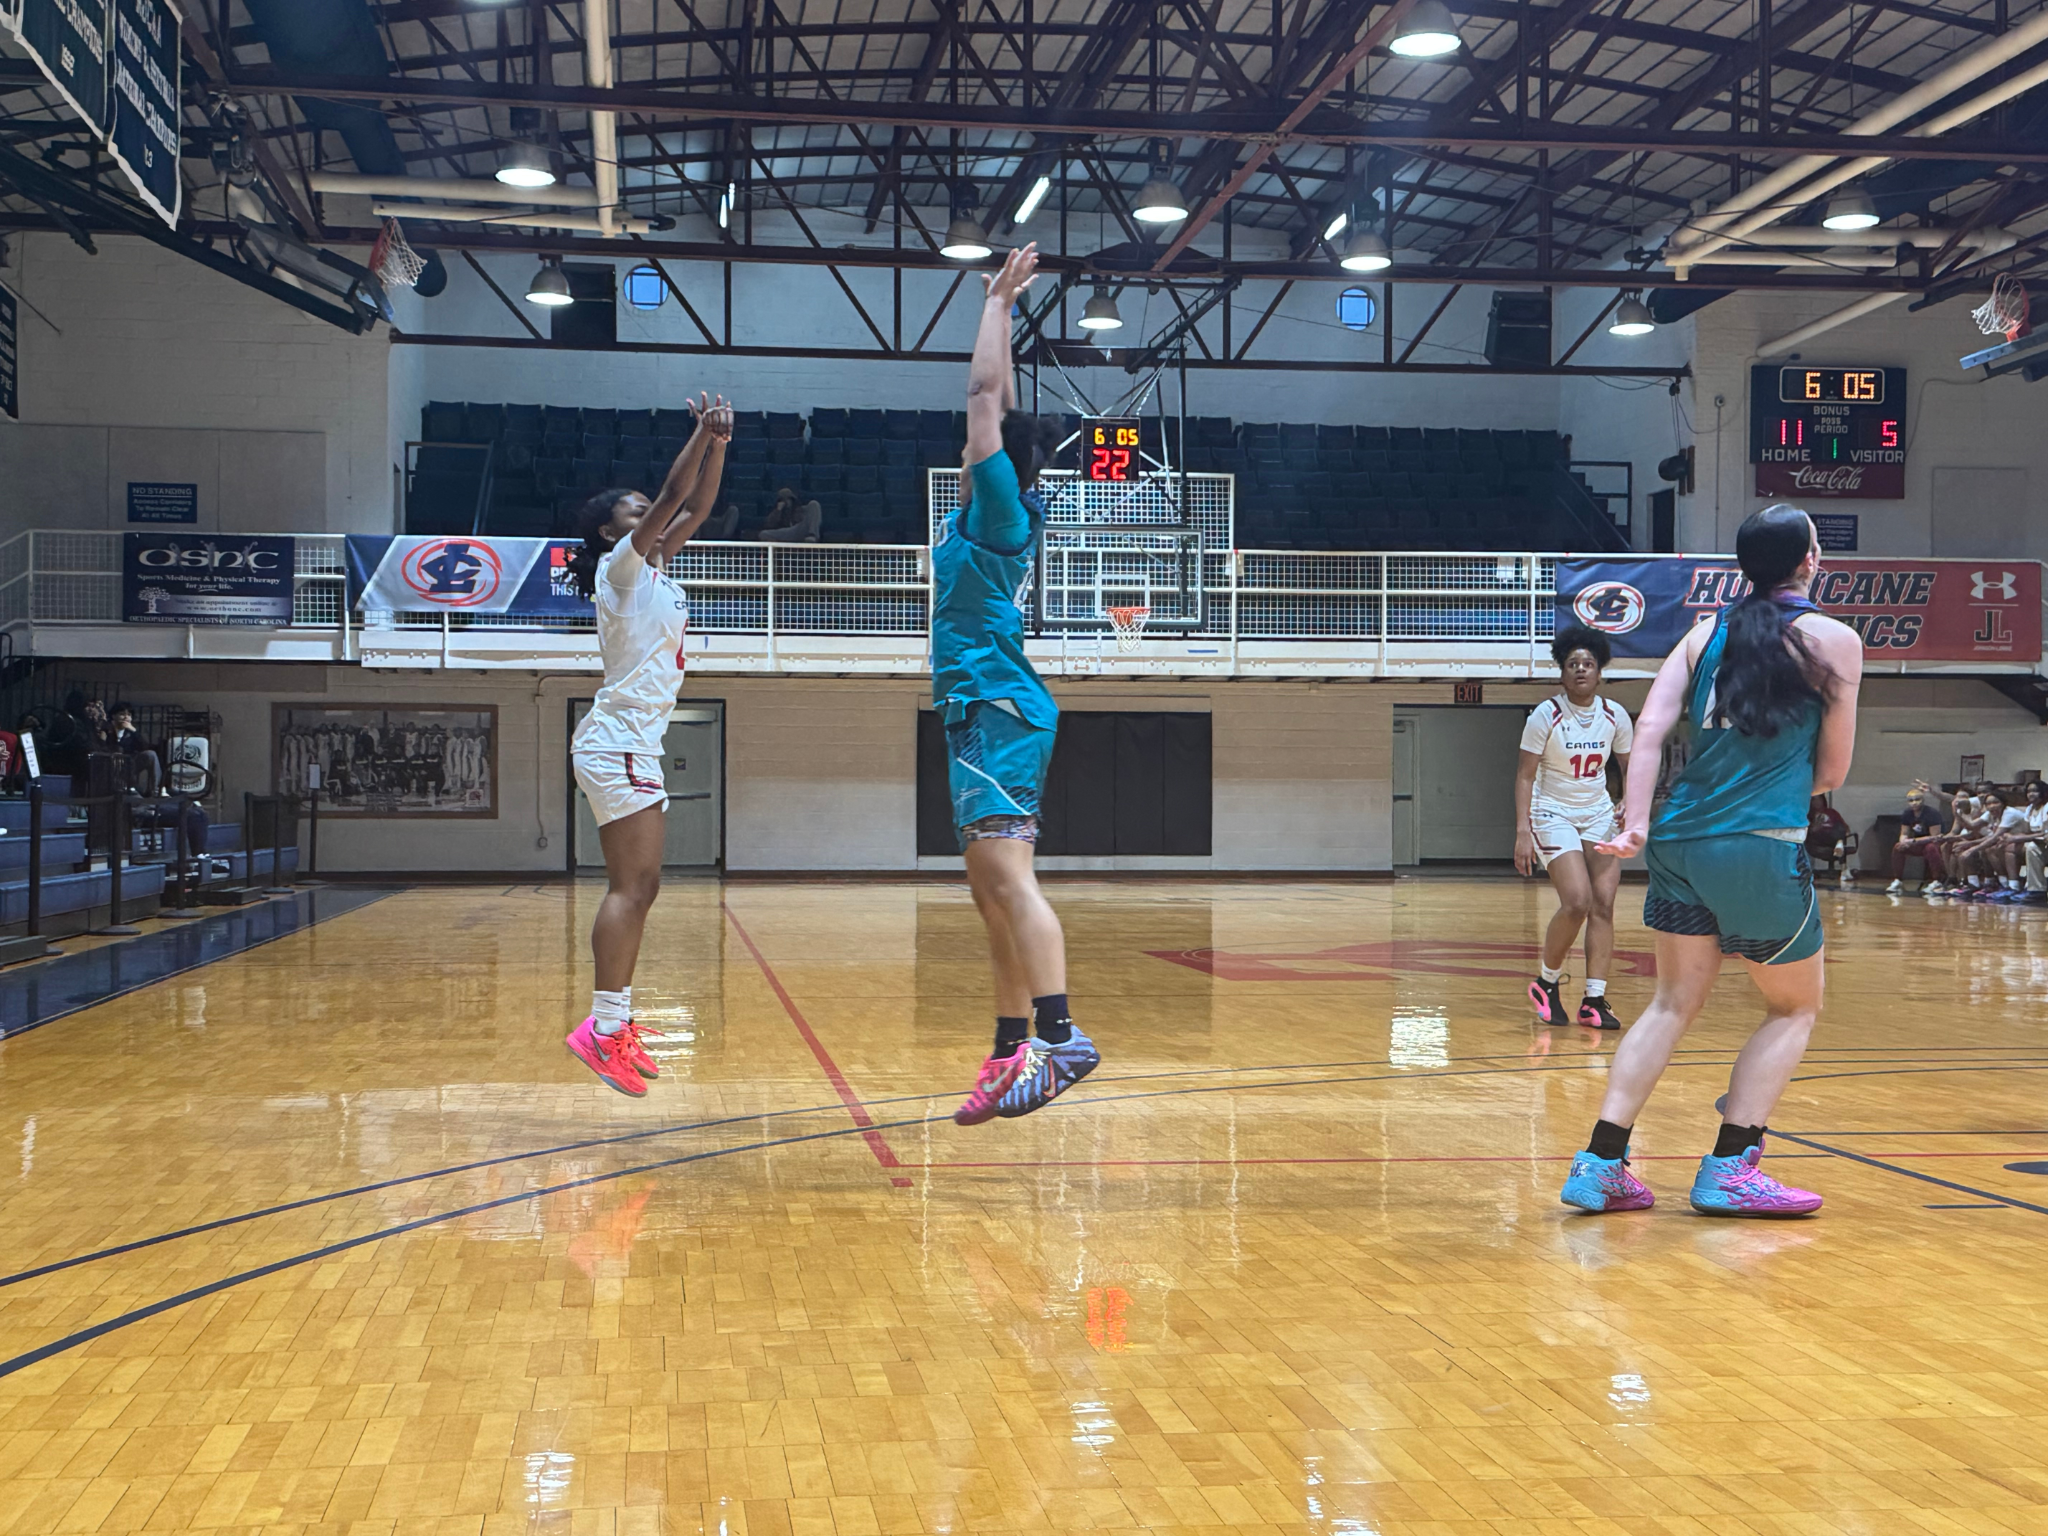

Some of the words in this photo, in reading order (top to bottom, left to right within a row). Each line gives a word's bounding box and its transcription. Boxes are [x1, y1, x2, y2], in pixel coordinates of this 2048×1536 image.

[1813, 405, 1850, 416] BONUS
[1821, 417, 1841, 425] POSS
[1781, 419, 1802, 445] 11
[1814, 425, 1848, 434] PERIOD
[1882, 421, 1897, 447] 5
[1762, 448, 1811, 462] HOME
[1850, 450, 1904, 463] VISITOR
[1091, 448, 1130, 480] 22
[1788, 465, 1866, 490] Coca-Cola
[147, 487, 192, 495] STANDING
[137, 573, 164, 582] Sports
[166, 574, 201, 582] Medicine
[213, 575, 245, 584] Physical
[248, 576, 280, 585] Therapy
[550, 584, 573, 596] THIS
[129, 615, 176, 623] ORTHOPAEDIC
[178, 616, 219, 624] SPECIALISTS
[229, 617, 253, 625] NORTH
[1457, 683, 1480, 702] EXIT
[1565, 741, 1606, 749] CANES
